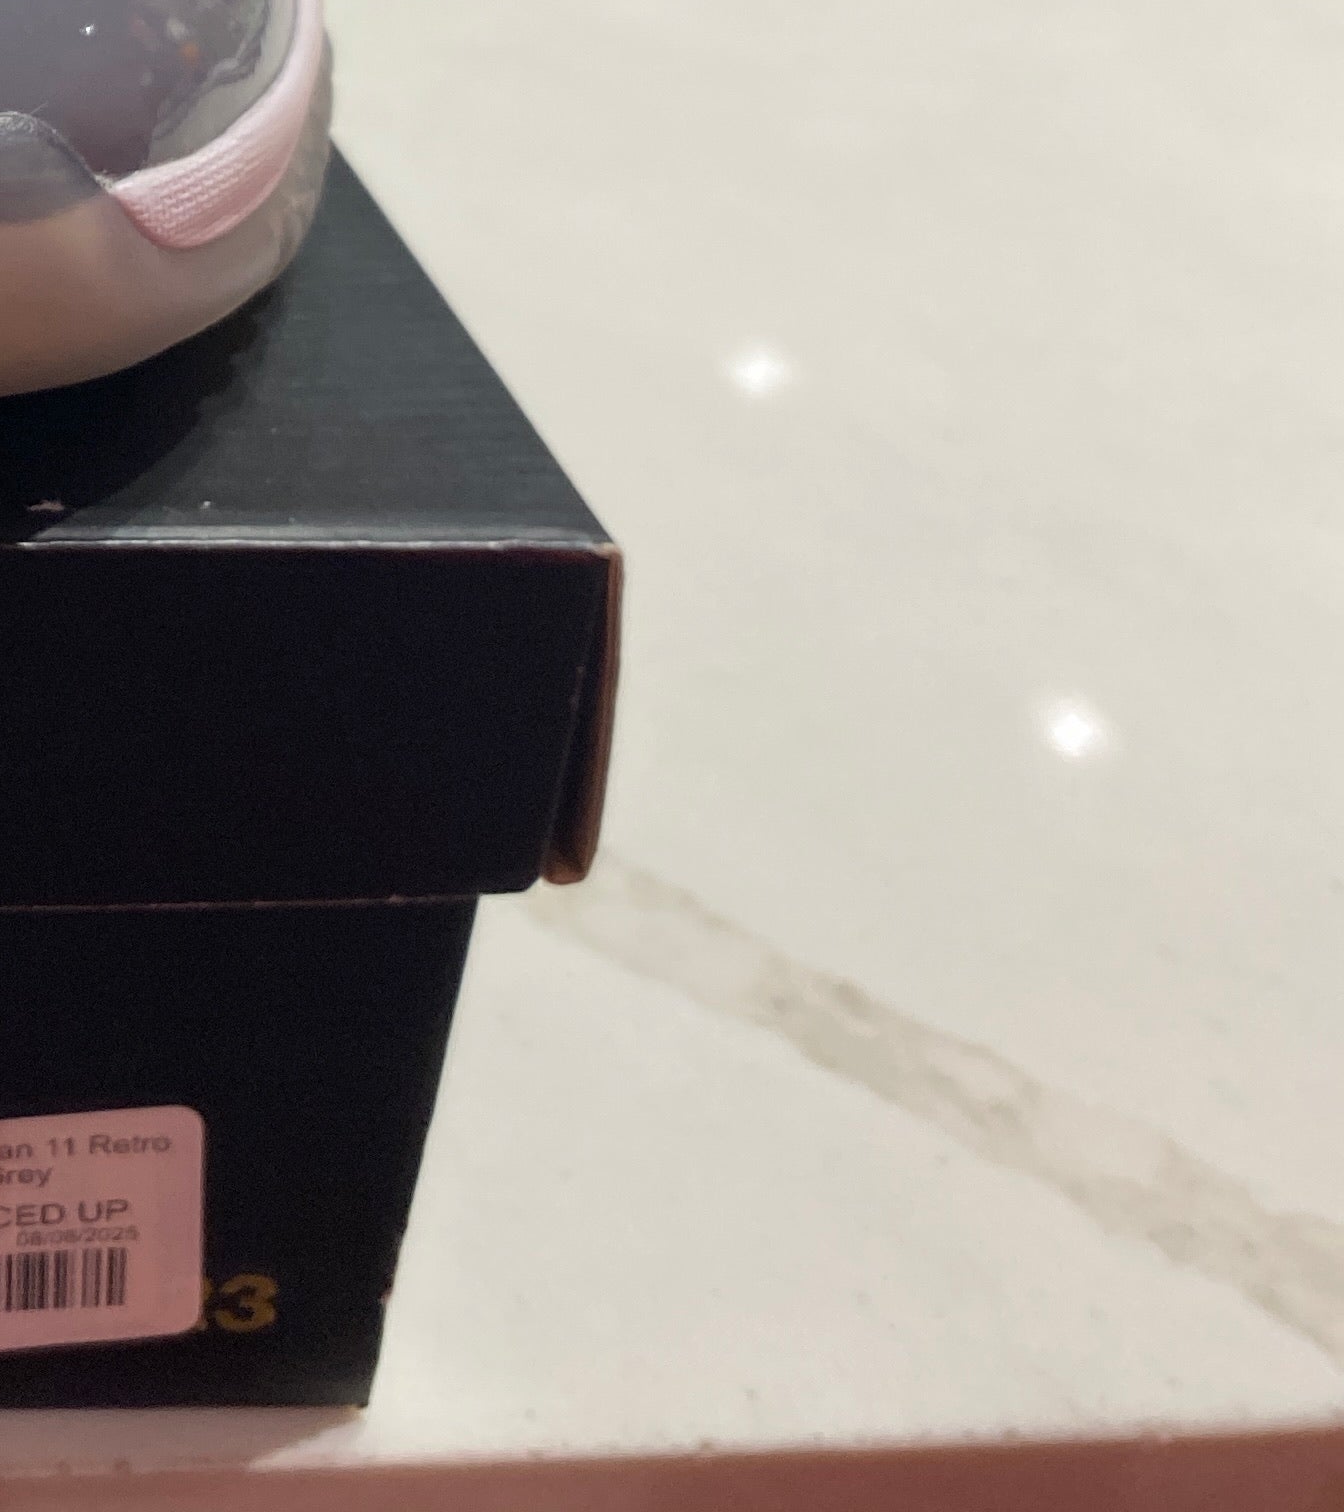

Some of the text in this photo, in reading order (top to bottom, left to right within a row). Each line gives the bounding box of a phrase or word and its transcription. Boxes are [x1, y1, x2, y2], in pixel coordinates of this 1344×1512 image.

[49, 1137, 76, 1159] 11
[90, 1134, 172, 1157] Retro
[78, 1199, 129, 1225] UP
[200, 1273, 279, 1332] 3
